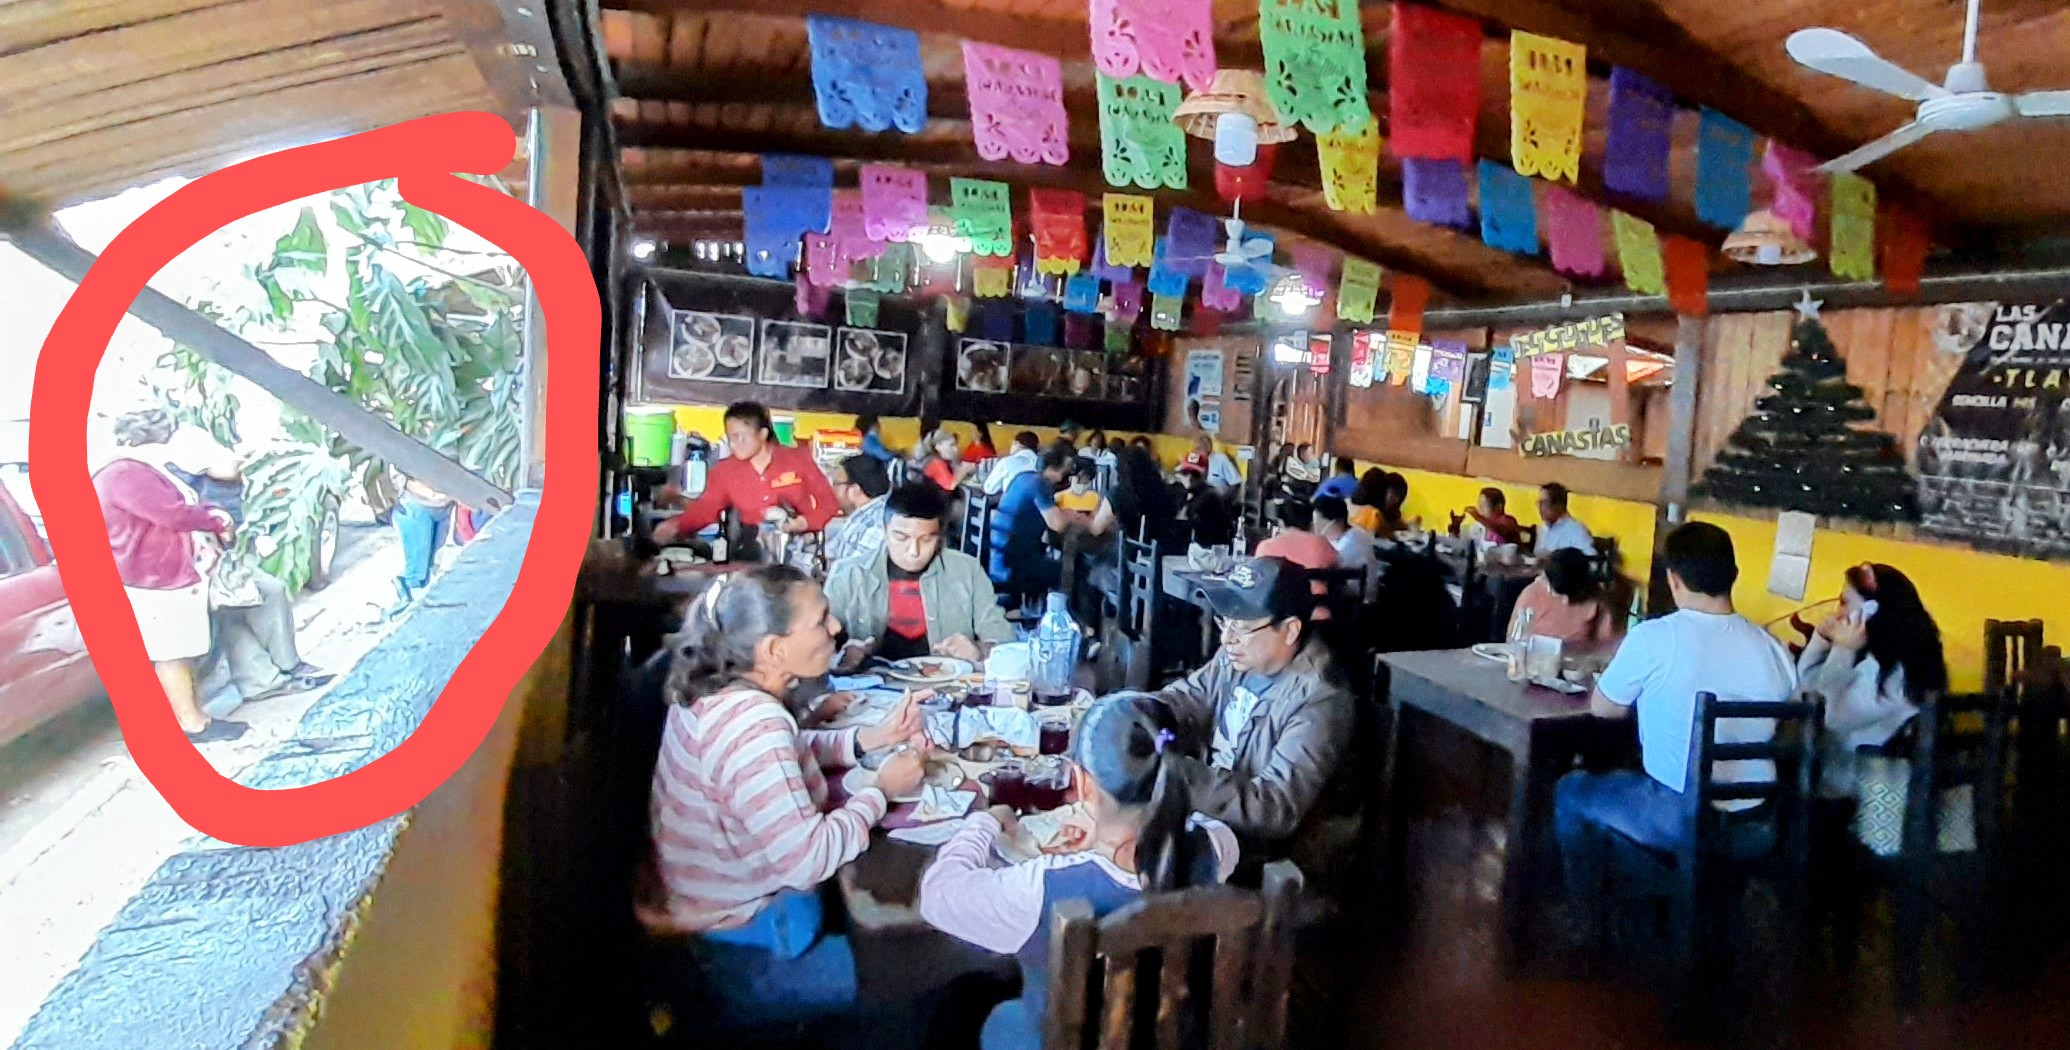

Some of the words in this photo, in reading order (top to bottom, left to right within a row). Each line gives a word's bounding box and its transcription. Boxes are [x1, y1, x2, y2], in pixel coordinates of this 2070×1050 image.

[1996, 304, 2037, 322] LAS
[2005, 367, 2070, 389] TLA
[1521, 426, 1629, 456] CANASTAS
